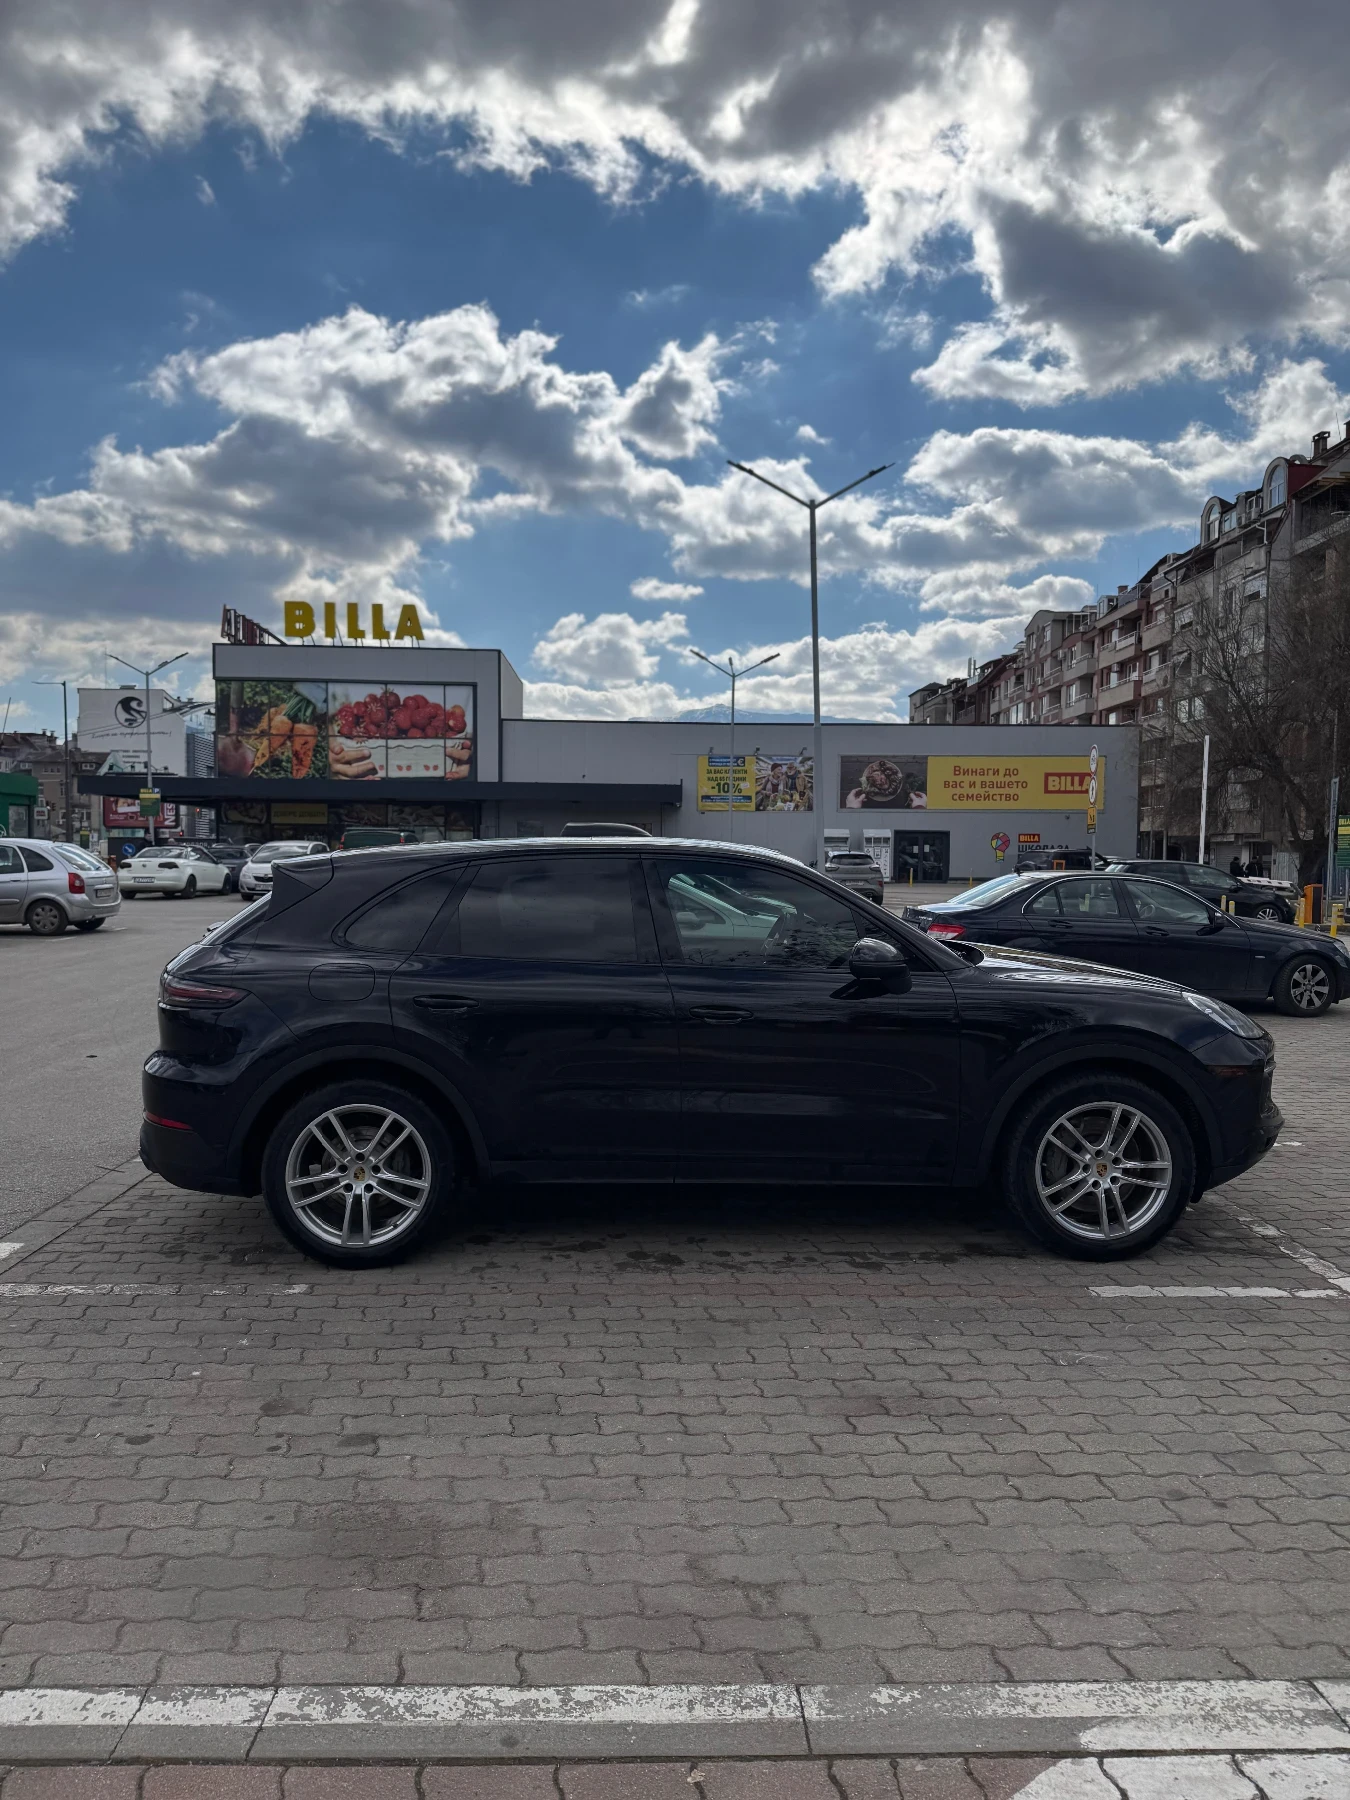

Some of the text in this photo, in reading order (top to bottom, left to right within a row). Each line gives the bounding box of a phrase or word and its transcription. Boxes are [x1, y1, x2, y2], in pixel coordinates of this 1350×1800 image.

[284, 600, 425, 641] BILLA
[953, 765, 1019, 778] Винаги до
[943, 780, 1028, 789] вас и вашето
[1047, 776, 1091, 791] BILLA
[951, 791, 1020, 802] семейство
[1019, 834, 1039, 842] BILLA
